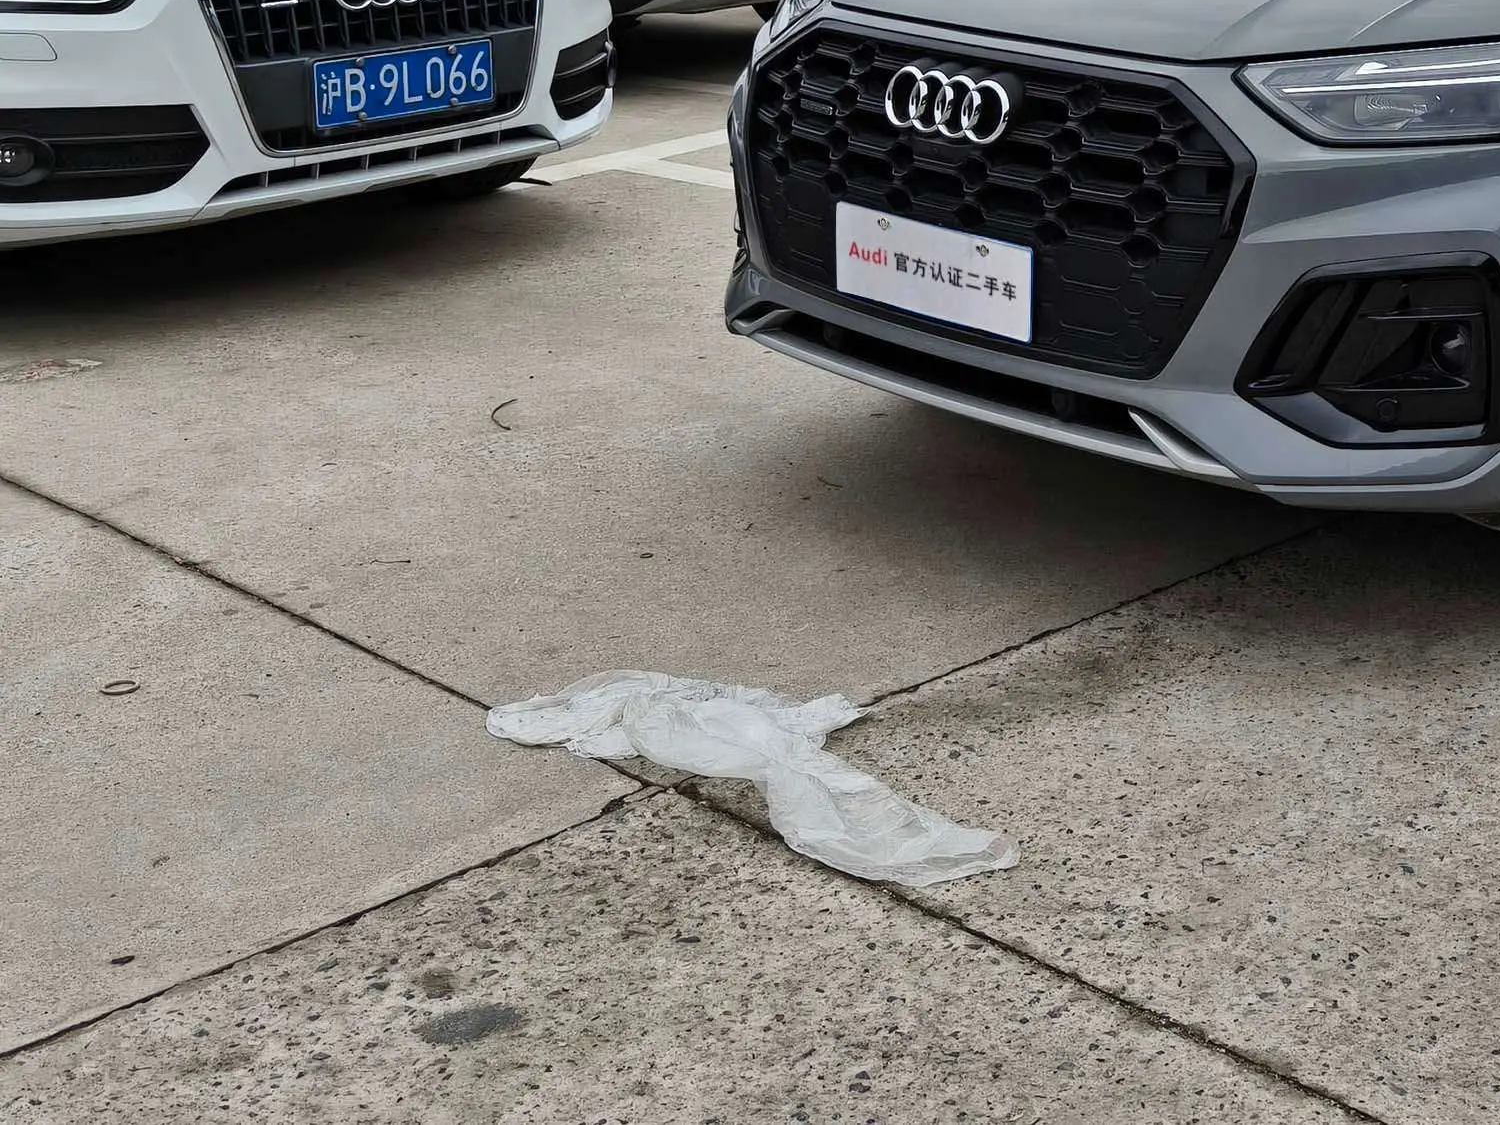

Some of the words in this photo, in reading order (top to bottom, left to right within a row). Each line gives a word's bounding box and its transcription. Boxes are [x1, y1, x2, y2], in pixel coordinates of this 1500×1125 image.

[321, 51, 488, 115] 沪B·9L066
[848, 241, 888, 266] Audi
[894, 251, 1017, 301] 官方认证二手车
